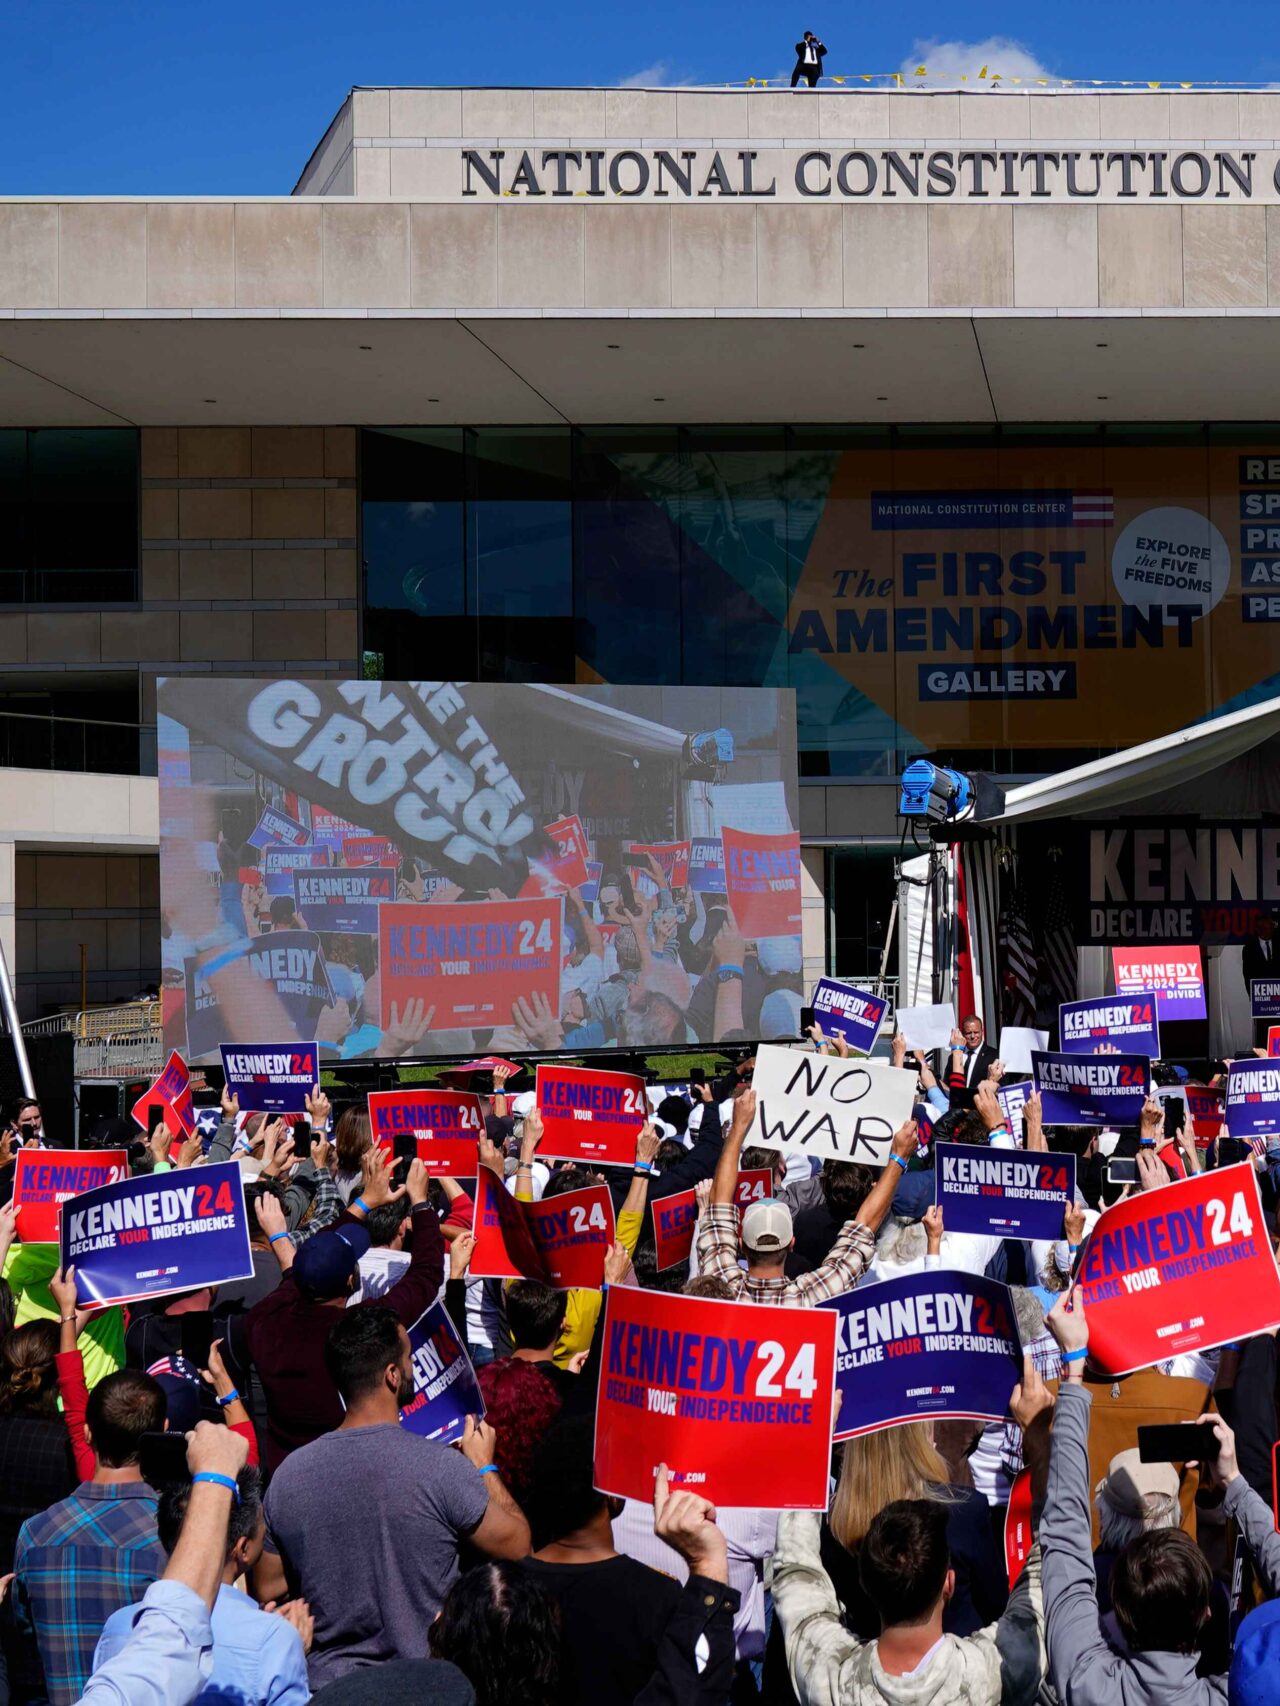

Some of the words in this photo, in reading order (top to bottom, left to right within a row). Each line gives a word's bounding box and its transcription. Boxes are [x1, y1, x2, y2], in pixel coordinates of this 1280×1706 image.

[461, 150, 777, 197] NATIONAL
[794, 150, 1257, 198] CONSTITUTION
[878, 504, 934, 515] NATIONAL
[937, 503, 1018, 514] CONSTITUTION
[1022, 502, 1066, 513] CENTER
[1135, 536, 1212, 561] EXPLORE
[832, 569, 895, 599] The
[902, 550, 1086, 597] FIRST
[1134, 554, 1158, 569] the
[1160, 557, 1198, 575] FIVE
[1124, 567, 1213, 594] FREEDOMS
[787, 604, 1203, 654] AMENDMENT
[927, 669, 1067, 694] GALLERY
[1090, 908, 1193, 938] DECLARE
[388, 918, 553, 960] KENNEDY24
[440, 961, 471, 976] YOUR
[1118, 962, 1198, 979] KENNEDY
[1146, 977, 1175, 990] 2024
[1166, 989, 1202, 999] DIVIDE
[816, 986, 882, 1022] KENNEDY24
[1063, 1003, 1153, 1032] KENNEDY24
[225, 1053, 314, 1075] KENNEDY24
[1038, 1060, 1145, 1088] KENNEDY24
[229, 1073, 255, 1083] DECLARE
[268, 1074, 314, 1084] INDEPENDENCE
[785, 1057, 872, 1104] NO
[1040, 1080, 1070, 1094] DECLARE
[1090, 1083, 1145, 1096] INDEPENDENCE
[542, 1080, 646, 1115] KENNEDY24
[376, 1104, 481, 1130] KENNEDY24
[573, 1109, 593, 1122] YOUR
[759, 1099, 894, 1159] WAR
[21, 1163, 126, 1191] KENNEDY24
[942, 1157, 1069, 1192] KENNEDY24
[943, 1181, 980, 1196] DECLARE
[981, 1184, 1004, 1198] YOUR
[1004, 1186, 1068, 1203] INDEPENDENCE
[69, 1180, 235, 1243] KENNEDY24
[68, 1234, 117, 1257] DECLARE
[118, 1228, 150, 1246] YOUR
[151, 1213, 236, 1241] INDEPENDENCE
[1121, 1267, 1162, 1295] YOUR
[1162, 1238, 1259, 1282] INDEPENDENCE
[836, 1292, 1012, 1353] KENNEDY24
[1156, 1316, 1206, 1338] KENNEDY24.COM
[609, 1319, 818, 1399] KENNEDY24
[886, 1337, 923, 1360] YOUR
[924, 1334, 1016, 1357] INDEPENDENCE
[402, 1391, 428, 1417] YOUR
[424, 1355, 467, 1401] INDEPENDENCE
[906, 1384, 956, 1397] KENNEDY24.COM
[606, 1379, 645, 1411] DECLARE
[647, 1387, 677, 1417] YOUR
[680, 1398, 813, 1426] INDEPENDENCE
